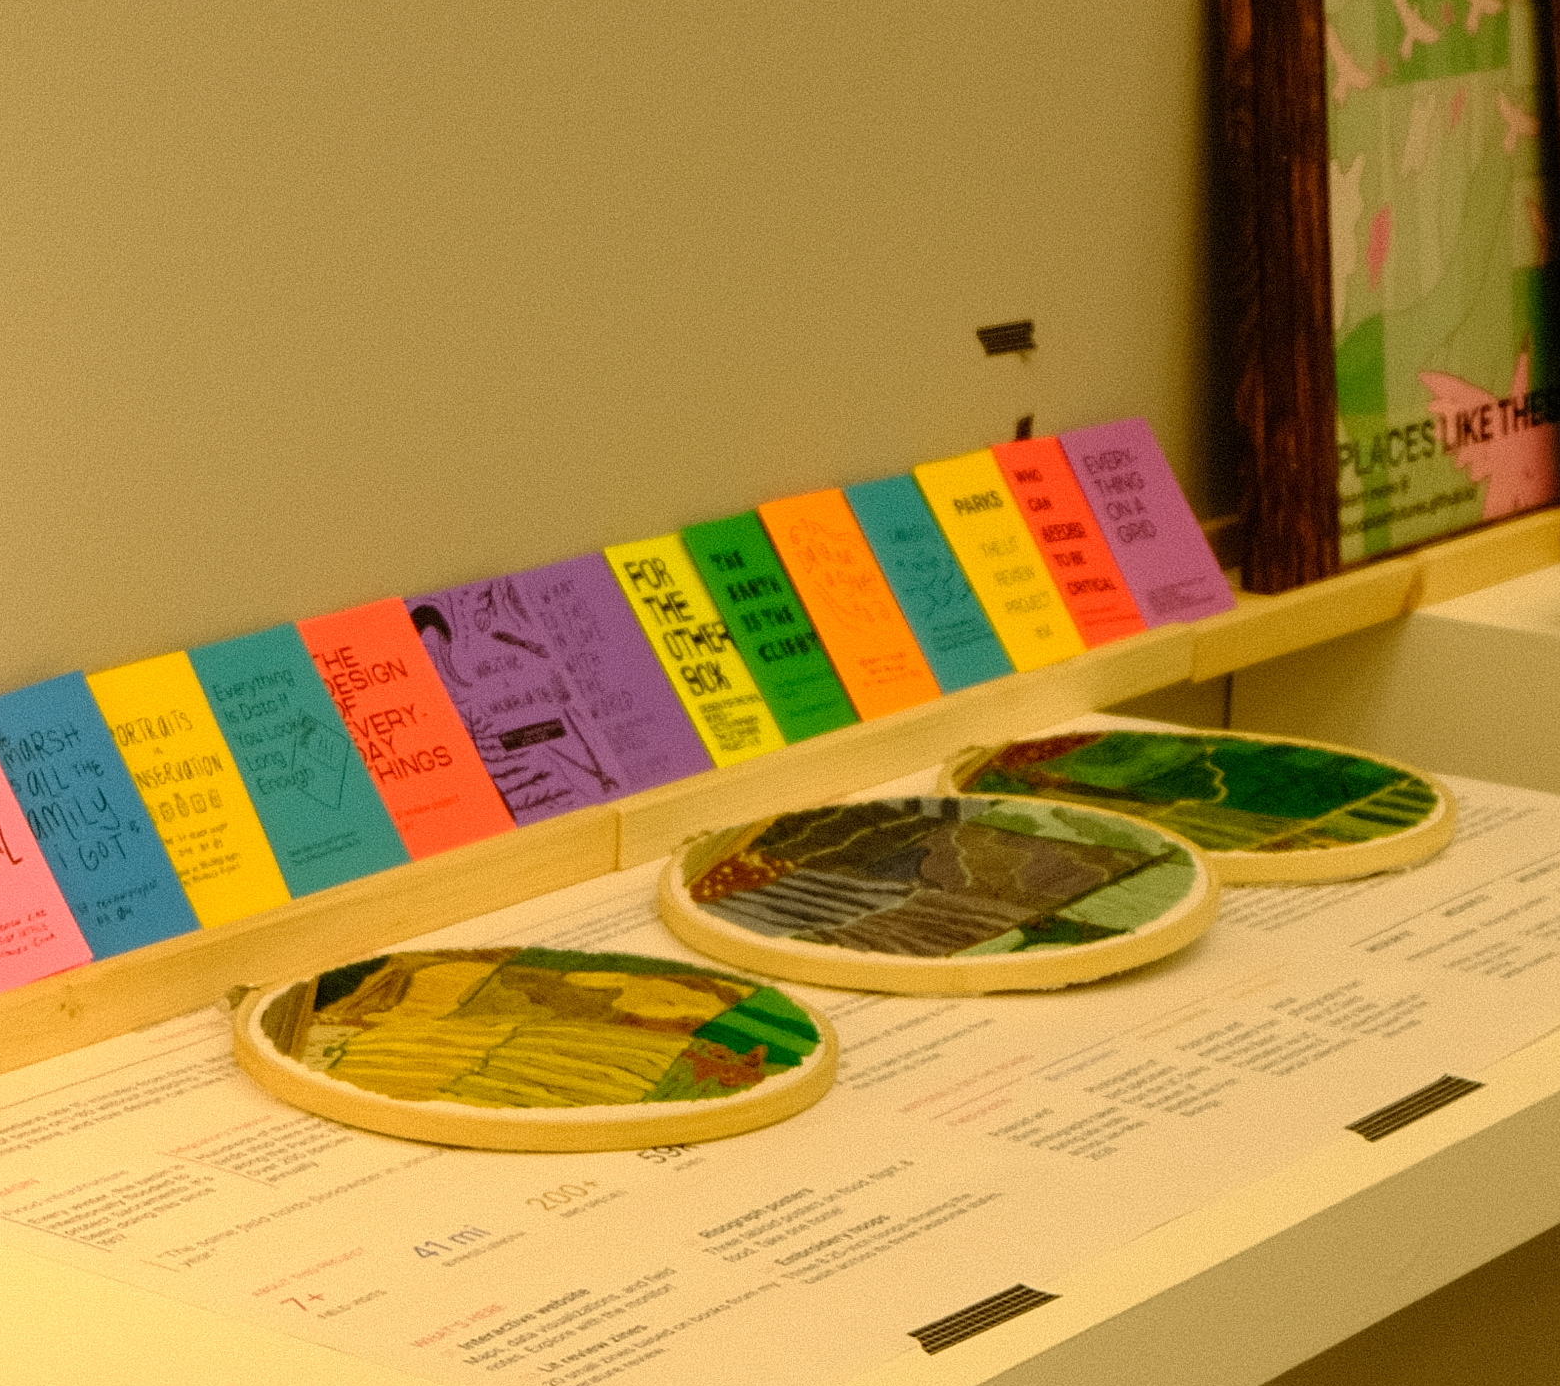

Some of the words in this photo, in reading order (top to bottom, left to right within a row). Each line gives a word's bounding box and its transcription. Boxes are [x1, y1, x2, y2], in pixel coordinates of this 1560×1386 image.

[1438, 403, 1494, 453] LIKE
[954, 490, 1003, 514] PARKS
[624, 557, 675, 593] FOR
[642, 590, 695, 627] THE
[367, 746, 453, 784] HINGS
[413, 1239, 451, 1261] 41
[448, 1224, 492, 1248] mi
